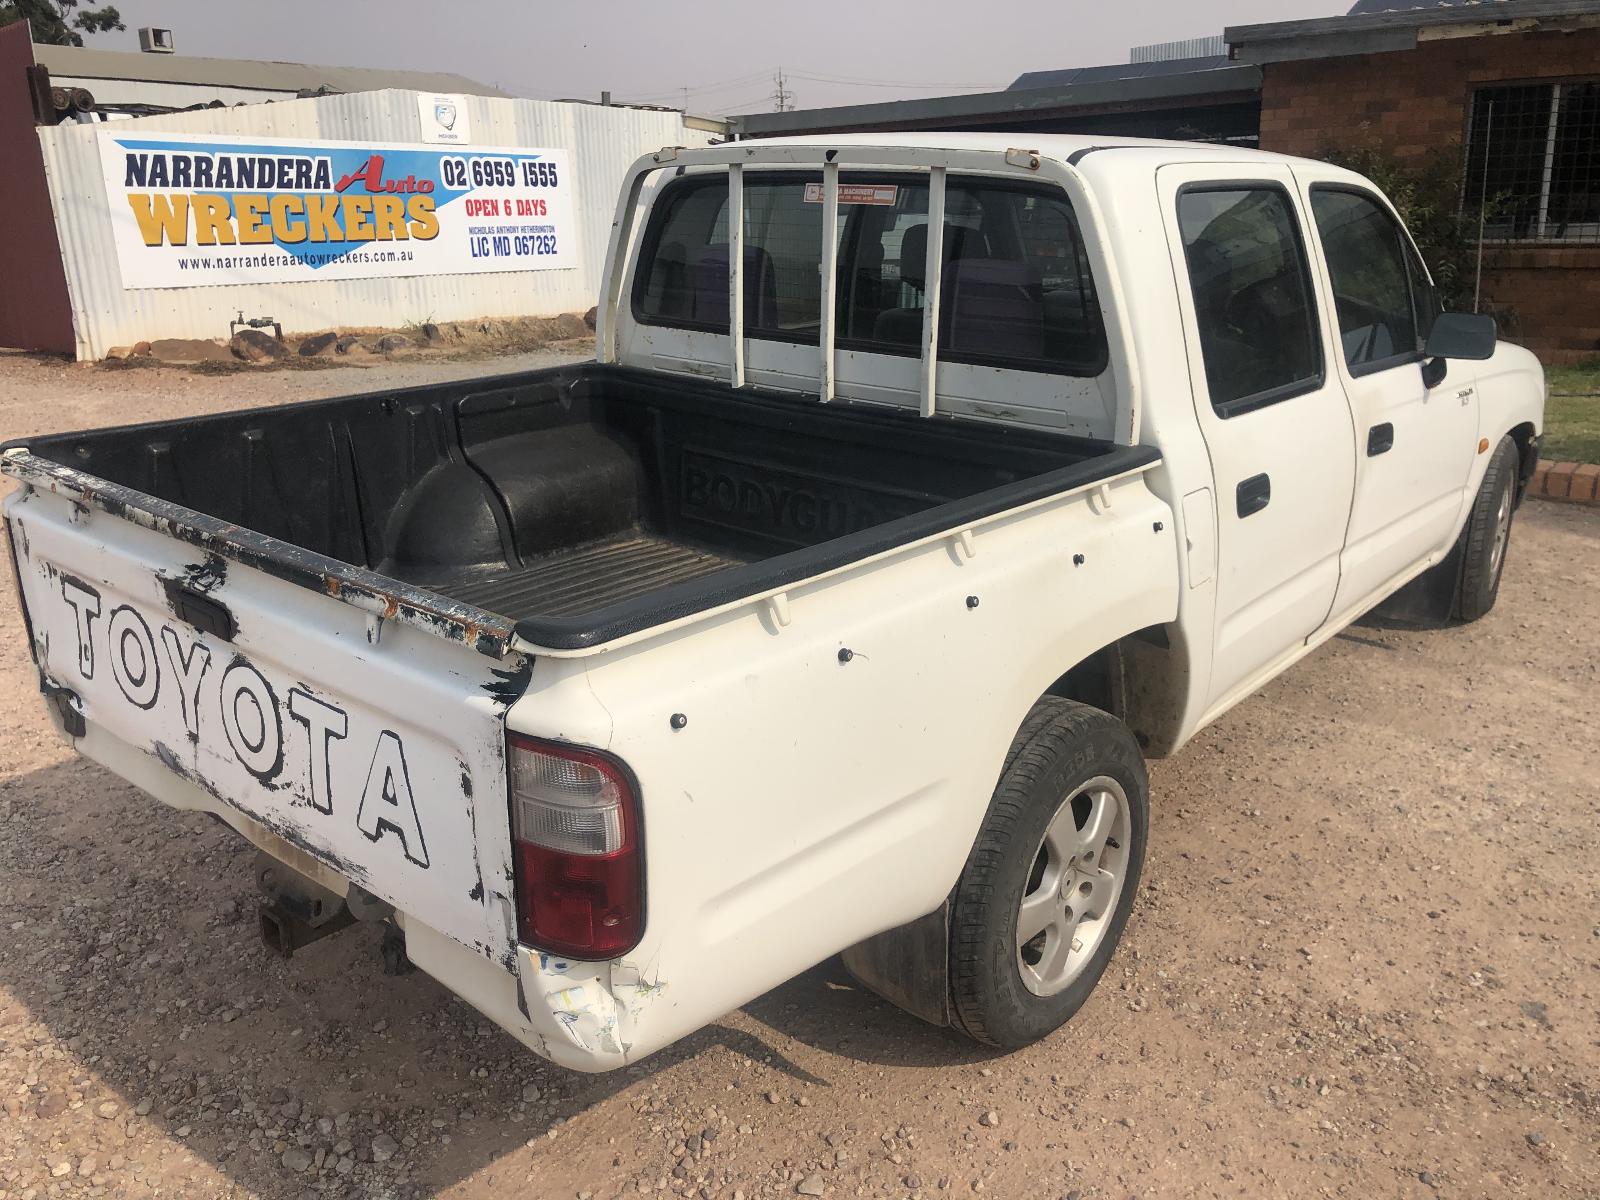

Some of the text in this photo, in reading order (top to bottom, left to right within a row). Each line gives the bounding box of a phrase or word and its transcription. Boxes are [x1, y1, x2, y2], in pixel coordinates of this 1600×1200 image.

[125, 153, 435, 193] NARRANDERA Auto
[443, 159, 558, 188] 02 6959 1555
[127, 193, 440, 248] WRECKERS
[465, 199, 547, 217] OPEN 6 DAYS
[468, 225, 556, 235] NICHOLAS ANTHONY HETHERINGTON
[470, 235, 558, 258] LIC MD 067262
[178, 250, 414, 270] www.narranderaautowreckers.com.au
[61, 571, 431, 869] TOYOTA
